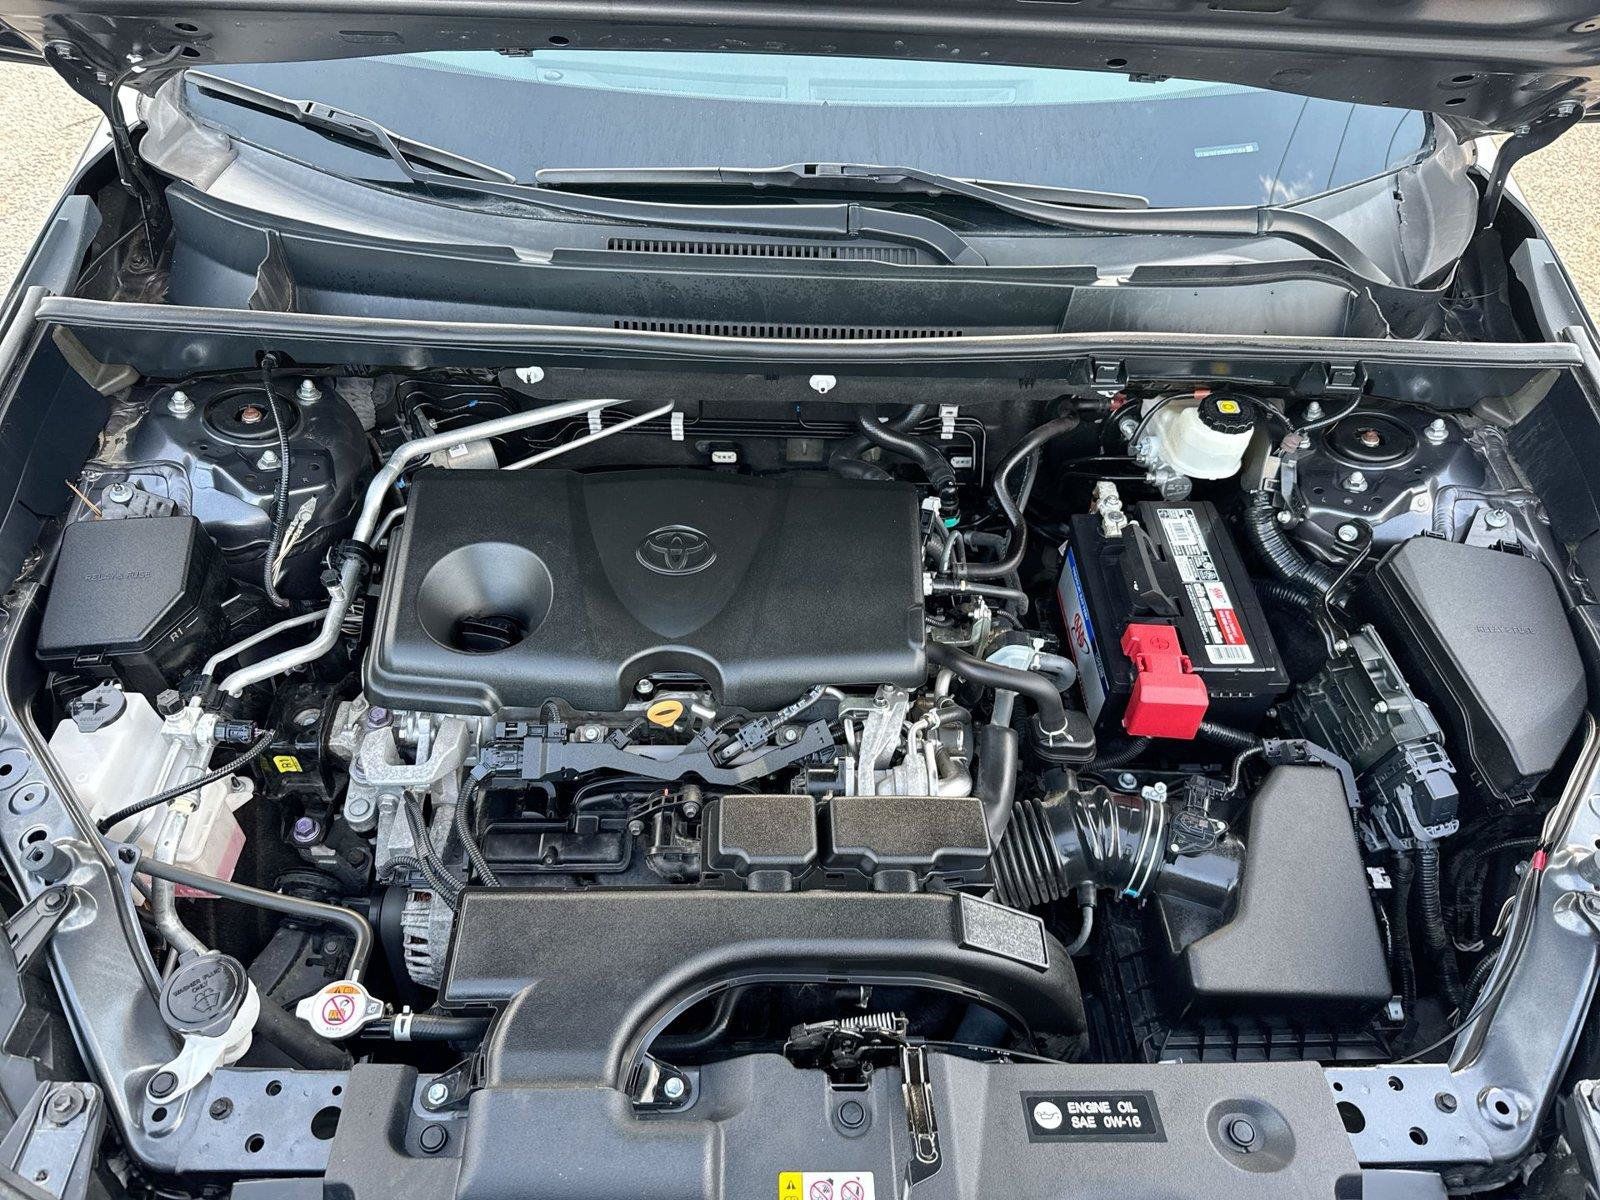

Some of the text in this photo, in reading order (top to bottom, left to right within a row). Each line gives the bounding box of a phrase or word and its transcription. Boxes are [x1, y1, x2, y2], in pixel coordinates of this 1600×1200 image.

[170, 627, 183, 642] R1
[1066, 1101, 1139, 1114] ENGINE OIL
[1071, 1116, 1141, 1128] SAE 0W-16
